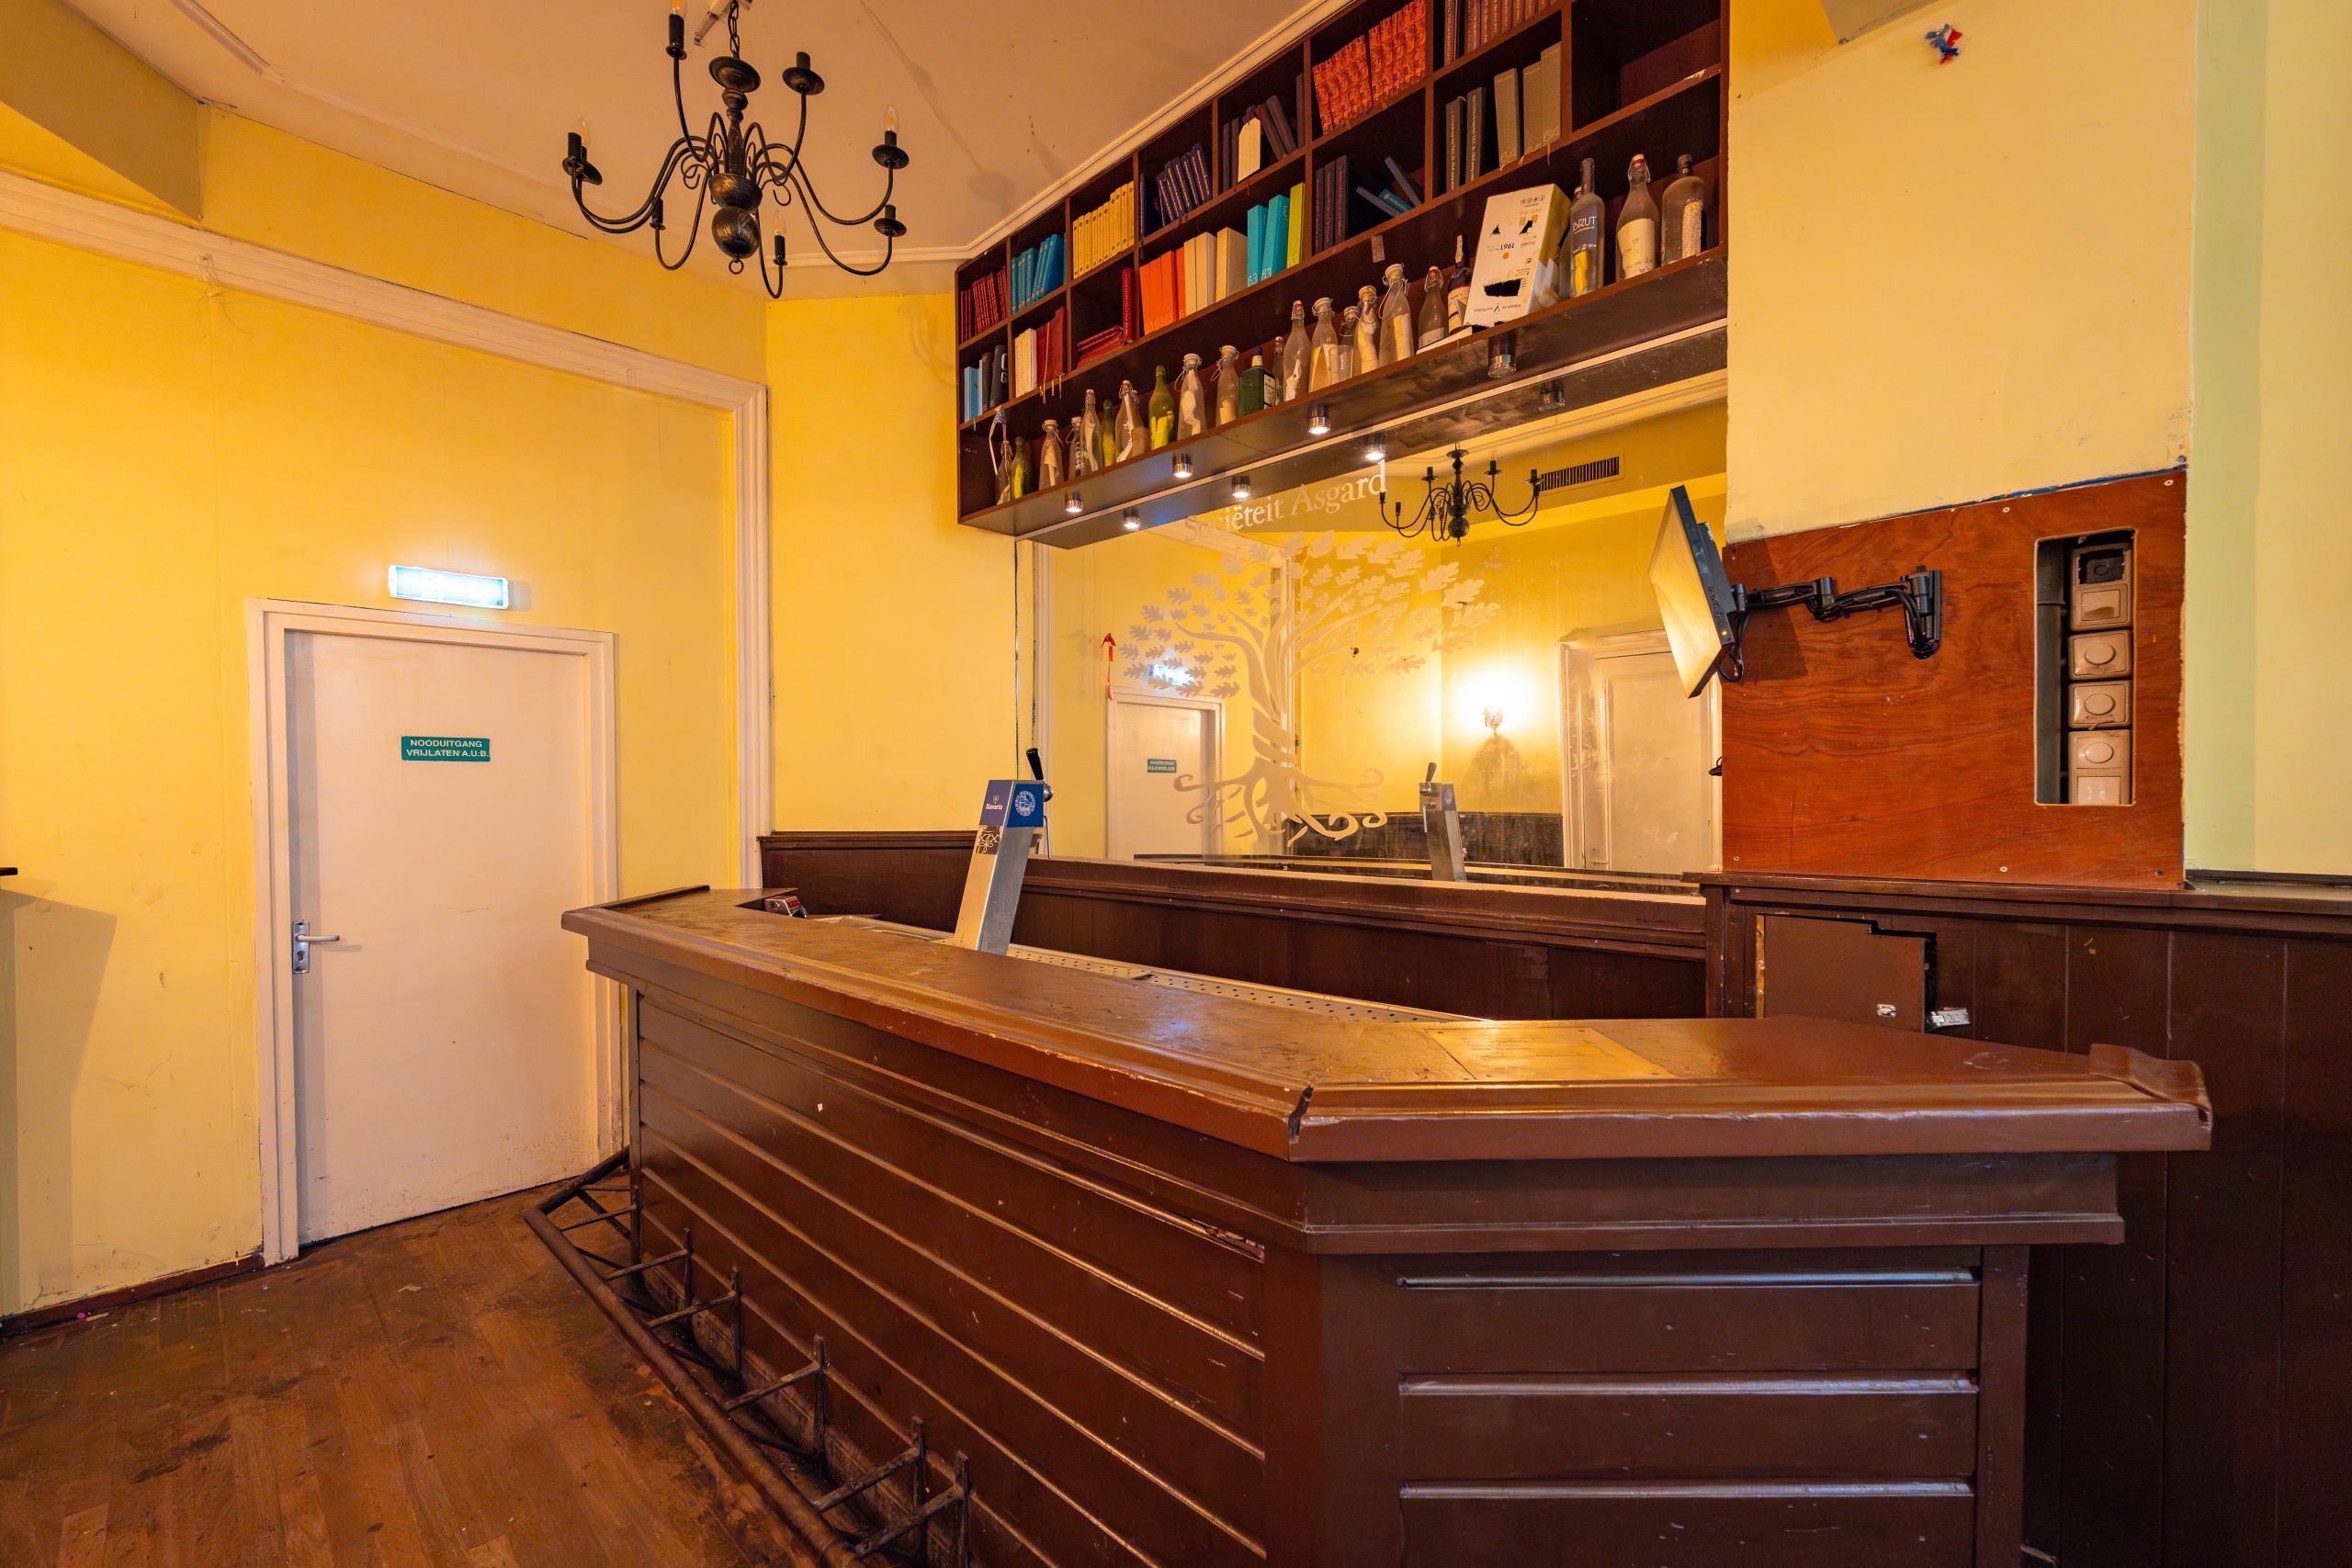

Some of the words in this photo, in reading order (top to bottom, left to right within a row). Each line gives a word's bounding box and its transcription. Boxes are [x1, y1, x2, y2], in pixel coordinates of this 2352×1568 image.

[1572, 216, 1598, 231] BRUT
[1184, 495, 1284, 542] Soiëteit
[1290, 458, 1387, 515] Asgard
[410, 739, 482, 748] NOODUITGANG
[406, 749, 460, 757] VRIJLATEN
